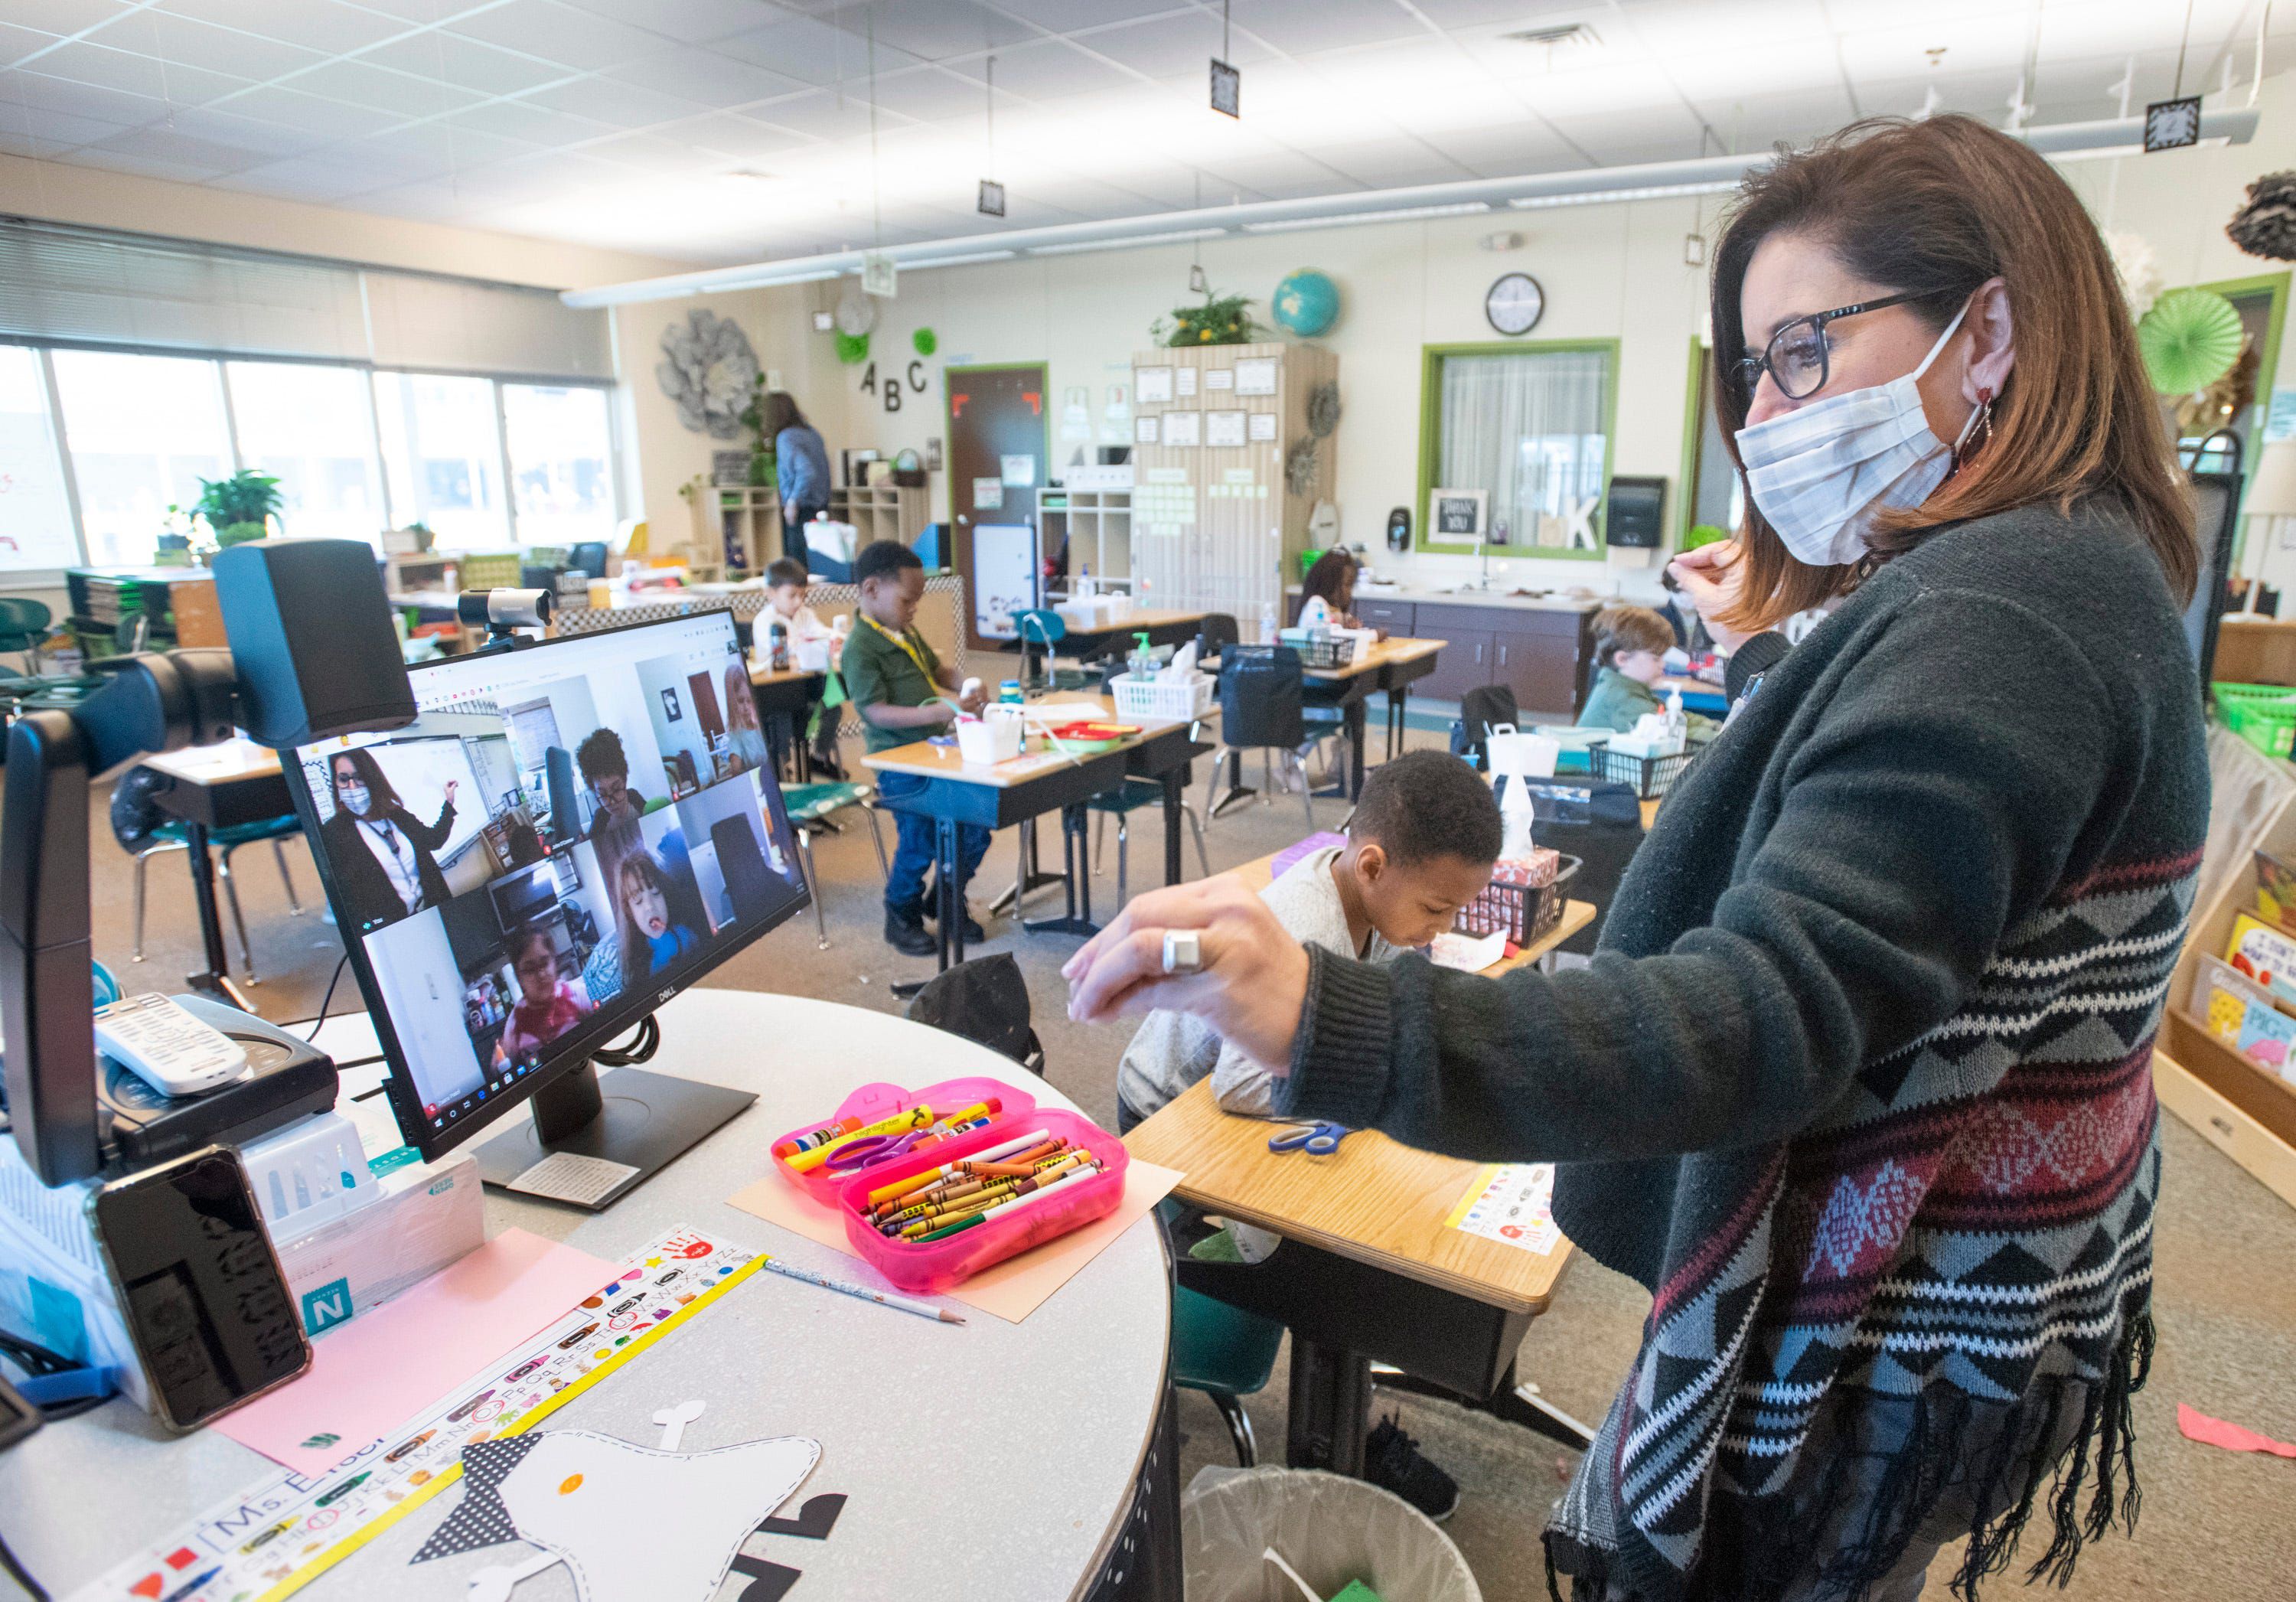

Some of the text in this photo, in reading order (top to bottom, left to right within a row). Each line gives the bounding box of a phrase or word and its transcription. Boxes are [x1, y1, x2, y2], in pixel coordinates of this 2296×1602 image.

[859, 360, 926, 412] A B C
[1448, 516, 1468, 530] YOU
[1566, 495, 1598, 550] K
[658, 986, 677, 1002] DELL
[2249, 1007, 2281, 1037] PIG
[855, 1118, 900, 1139] highlighter
[690, 1245, 706, 1257] right
[312, 1293, 344, 1326] N
[214, 1499, 289, 1537] Ms.
